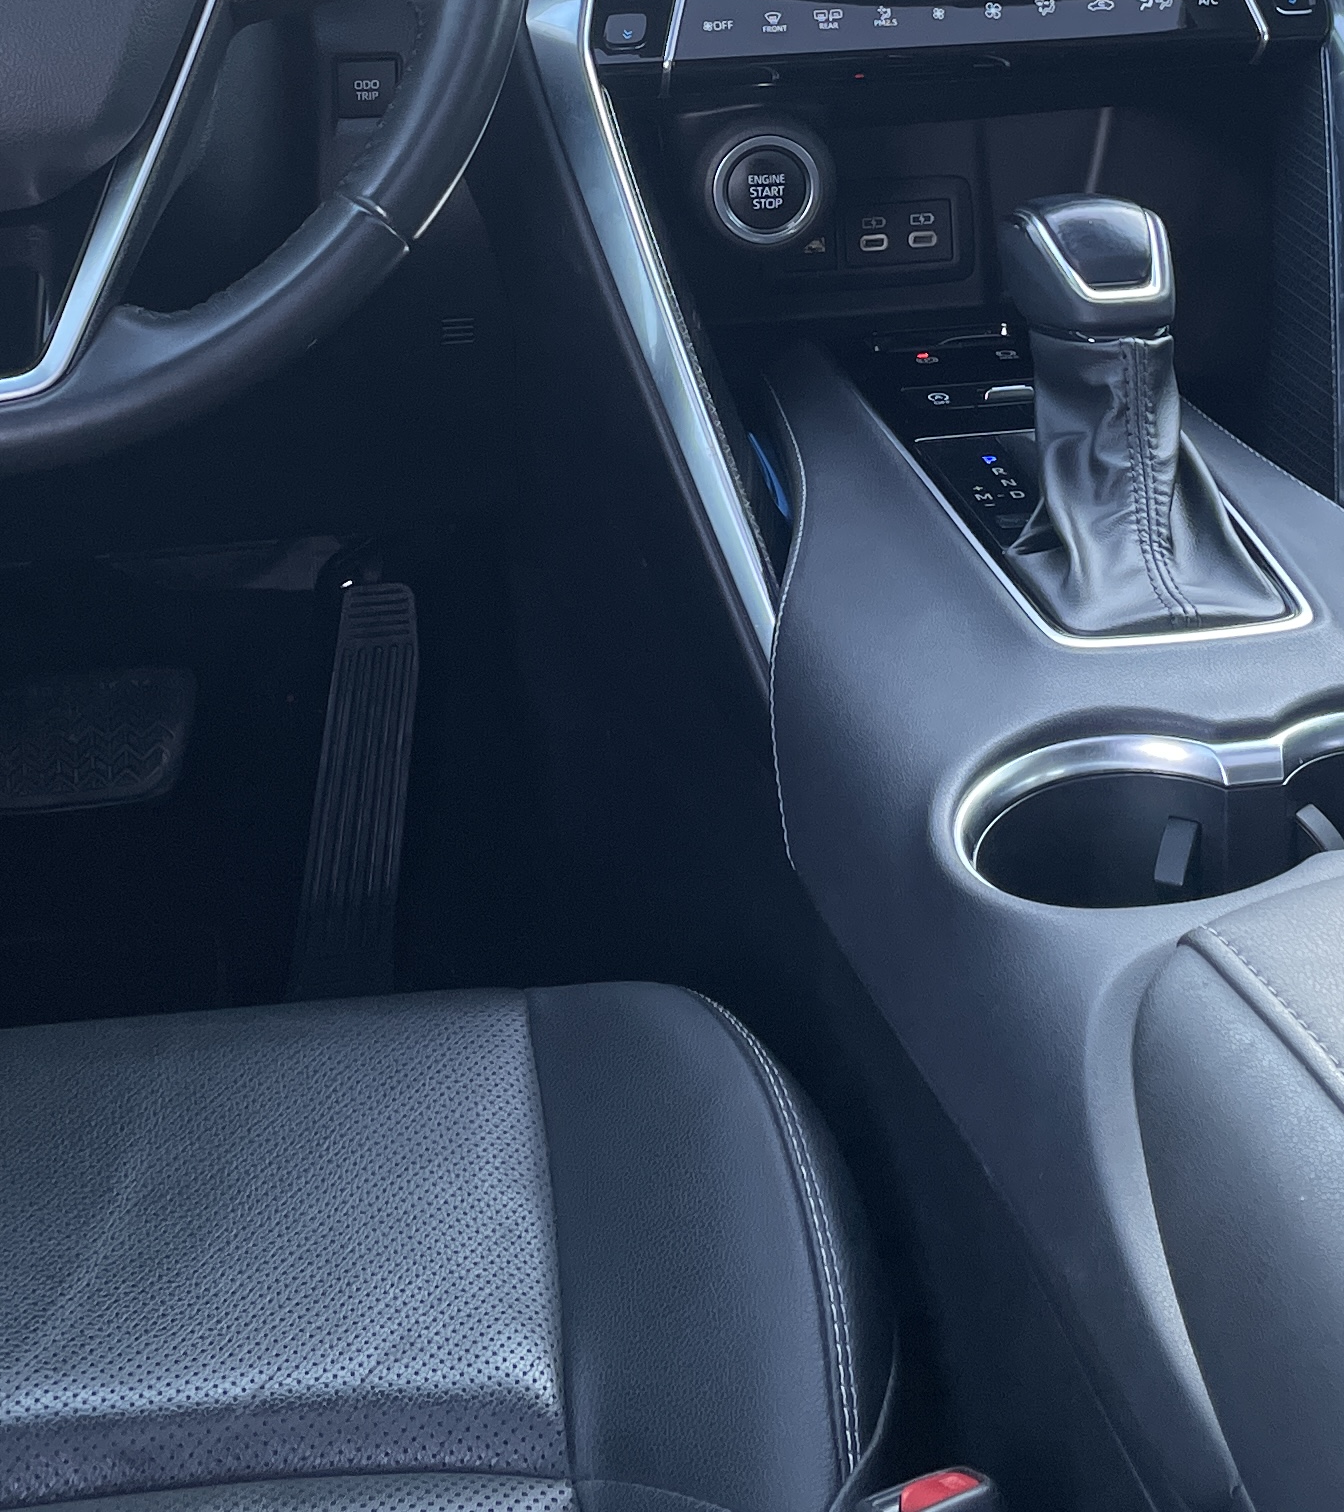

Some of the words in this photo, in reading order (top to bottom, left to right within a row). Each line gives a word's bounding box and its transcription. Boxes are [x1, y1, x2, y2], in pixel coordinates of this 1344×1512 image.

[714, 20, 734, 31] OFF
[818, 20, 839, 30] REAR
[873, 18, 898, 28] PM2.5
[762, 24, 787, 33] FRONT
[354, 79, 380, 90] ODO
[356, 91, 379, 101] TRIP
[748, 173, 786, 185] ENGINE
[749, 185, 785, 198] START
[752, 198, 783, 210] STOP
[982, 455, 997, 465] P
[991, 467, 1008, 476] R
[1000, 478, 1017, 487] N
[974, 492, 994, 501] M
[1009, 490, 1026, 499] D
